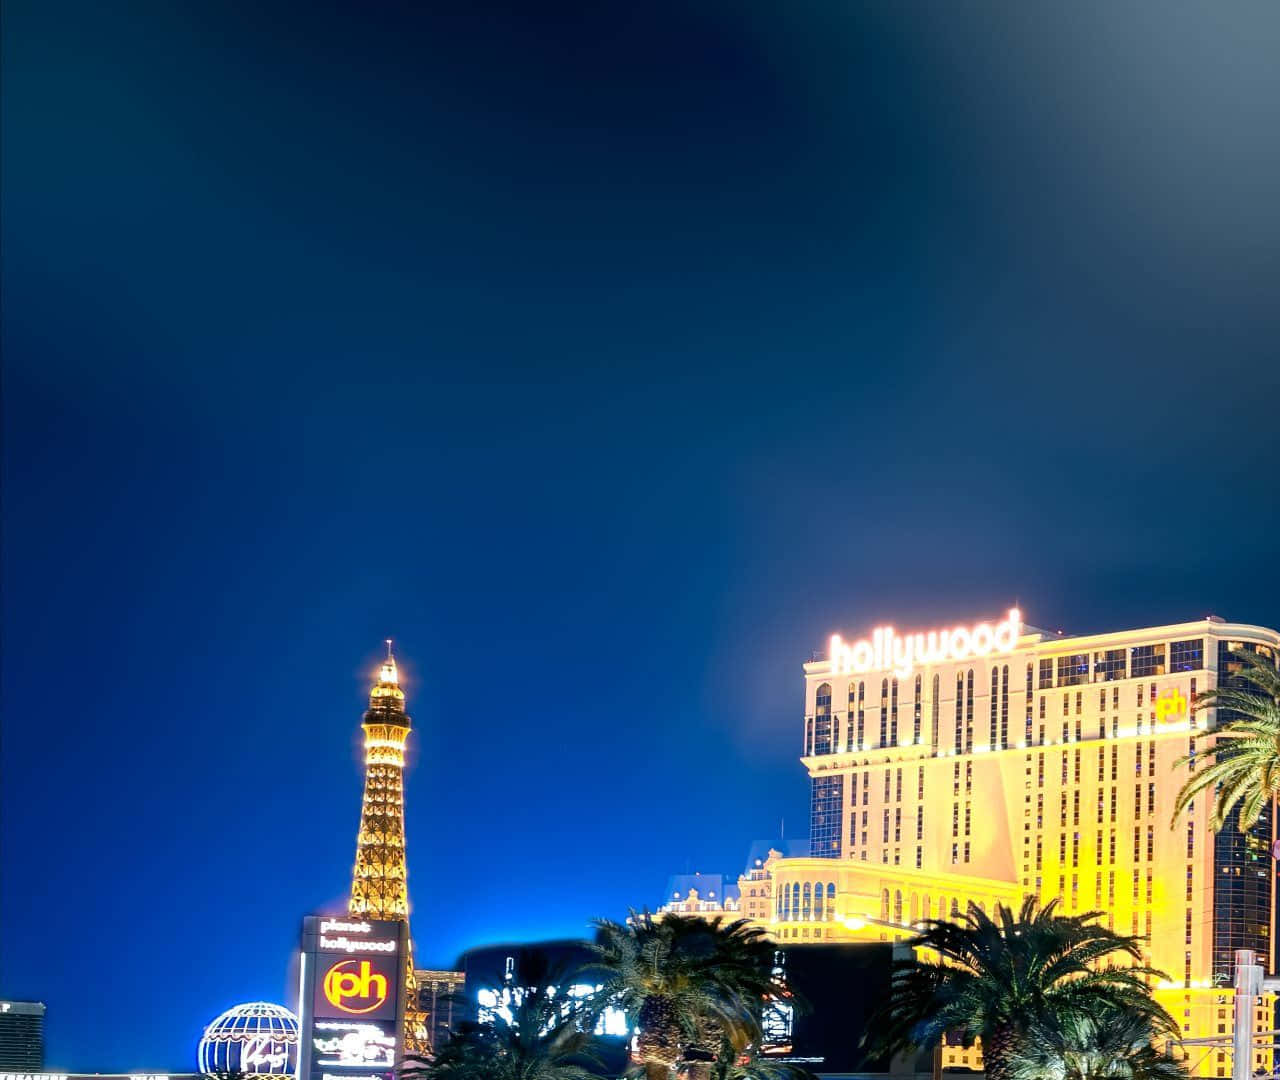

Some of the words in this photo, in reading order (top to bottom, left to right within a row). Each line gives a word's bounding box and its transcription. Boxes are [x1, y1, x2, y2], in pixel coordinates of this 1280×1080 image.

[829, 606, 1021, 680] hollywood
[320, 919, 372, 933] planet
[319, 936, 396, 952] hollywood
